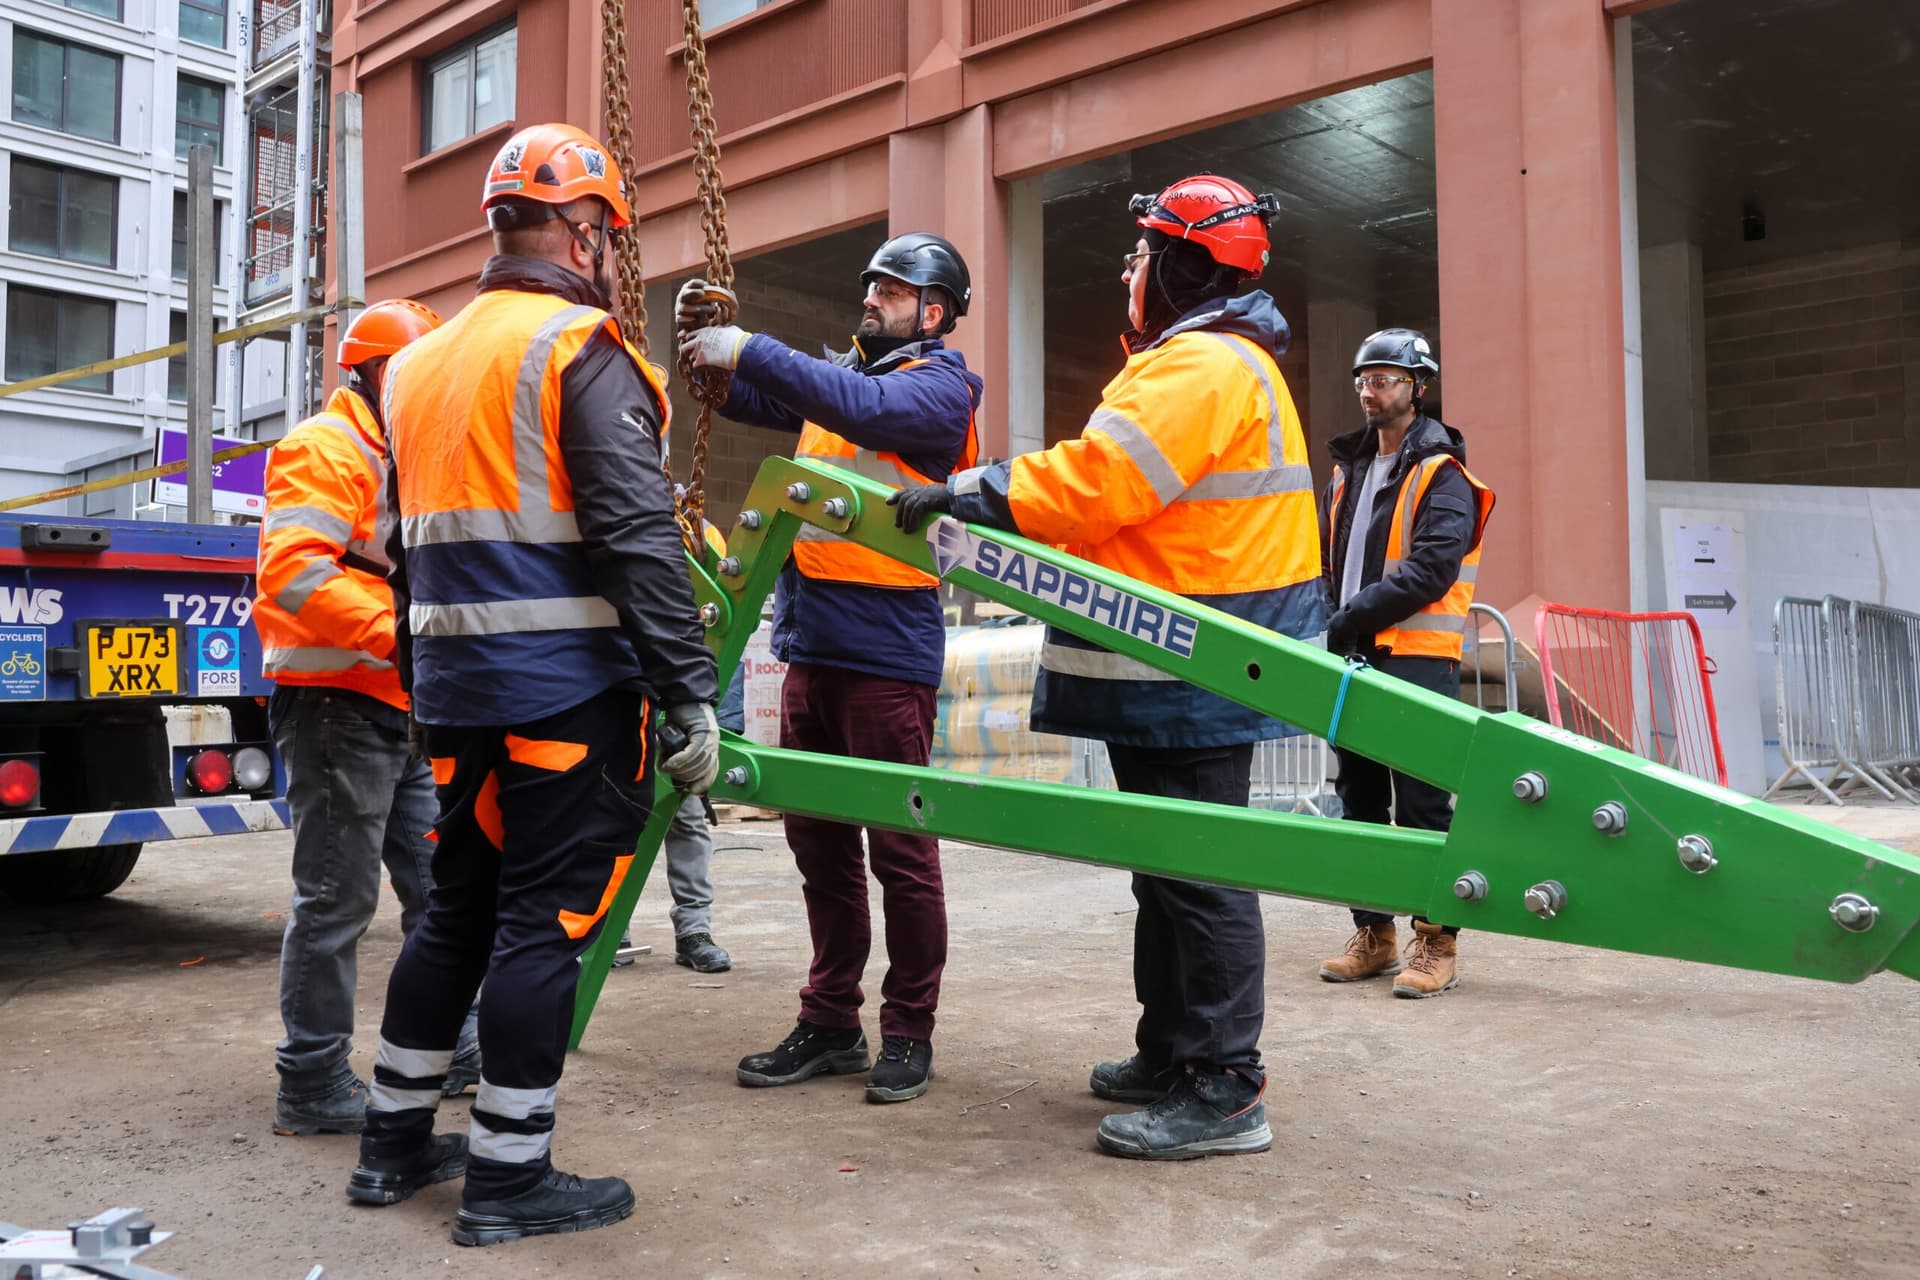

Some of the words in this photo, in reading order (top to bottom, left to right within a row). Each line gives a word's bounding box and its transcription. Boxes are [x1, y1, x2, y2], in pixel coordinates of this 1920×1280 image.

[163, 593, 253, 627] T279
[975, 539, 1197, 657] SAPPHIRE
[0, 633, 43, 642] CYCLISTS
[97, 632, 170, 660] PJ73
[107, 664, 162, 691] XRX
[201, 671, 238, 685] FORS
